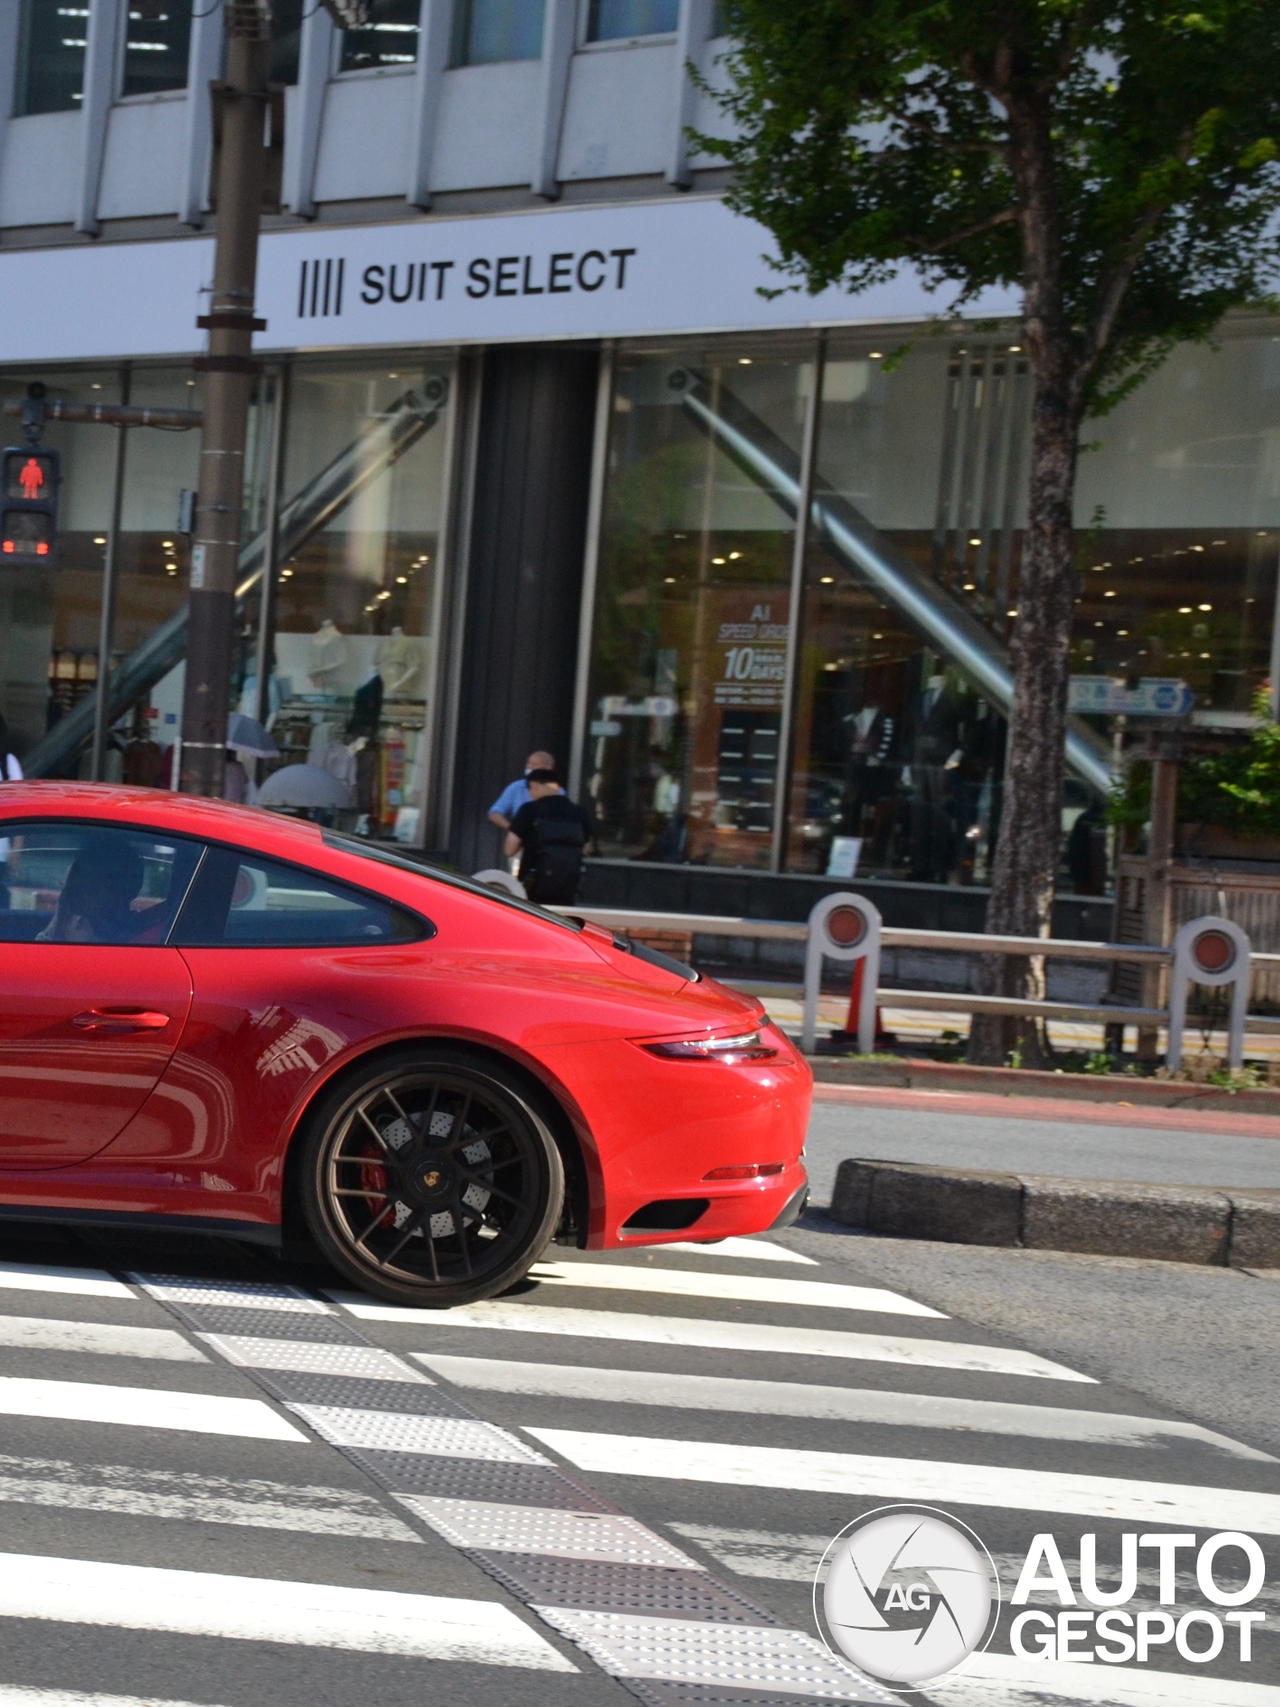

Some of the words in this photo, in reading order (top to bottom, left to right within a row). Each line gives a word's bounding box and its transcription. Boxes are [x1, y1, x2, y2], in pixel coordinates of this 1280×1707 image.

[361, 260, 455, 305] SUIT
[465, 248, 637, 299] SELECT
[749, 604, 771, 621] AI
[718, 623, 758, 639] SPEED
[724, 647, 755, 680] 10
[750, 665, 786, 680] DAYS
